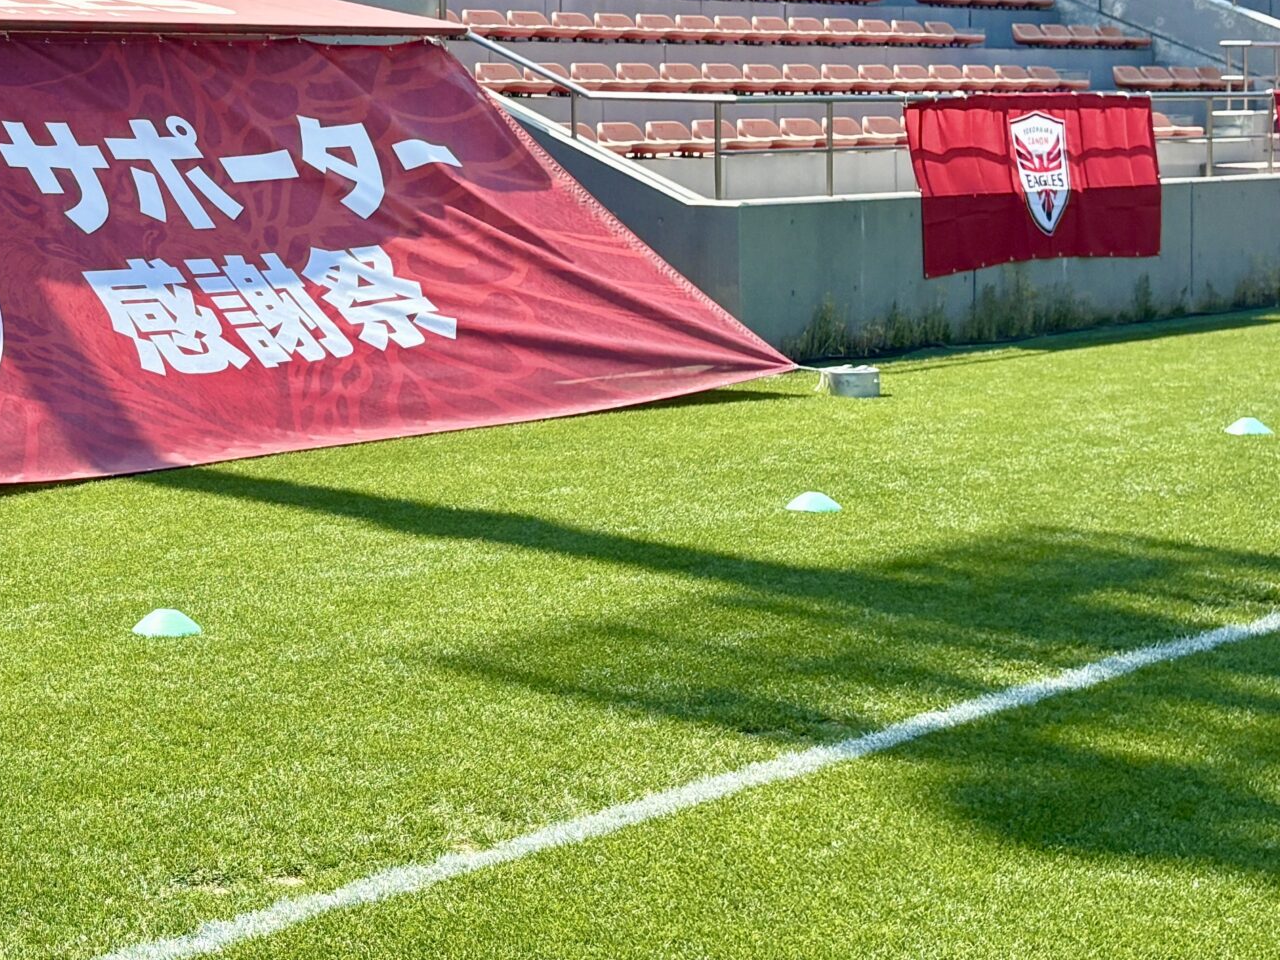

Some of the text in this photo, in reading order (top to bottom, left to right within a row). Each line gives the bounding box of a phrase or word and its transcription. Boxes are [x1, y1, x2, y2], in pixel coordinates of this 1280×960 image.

[1025, 173, 1064, 188] EAGLES
[82, 245, 457, 376] 感謝祭
